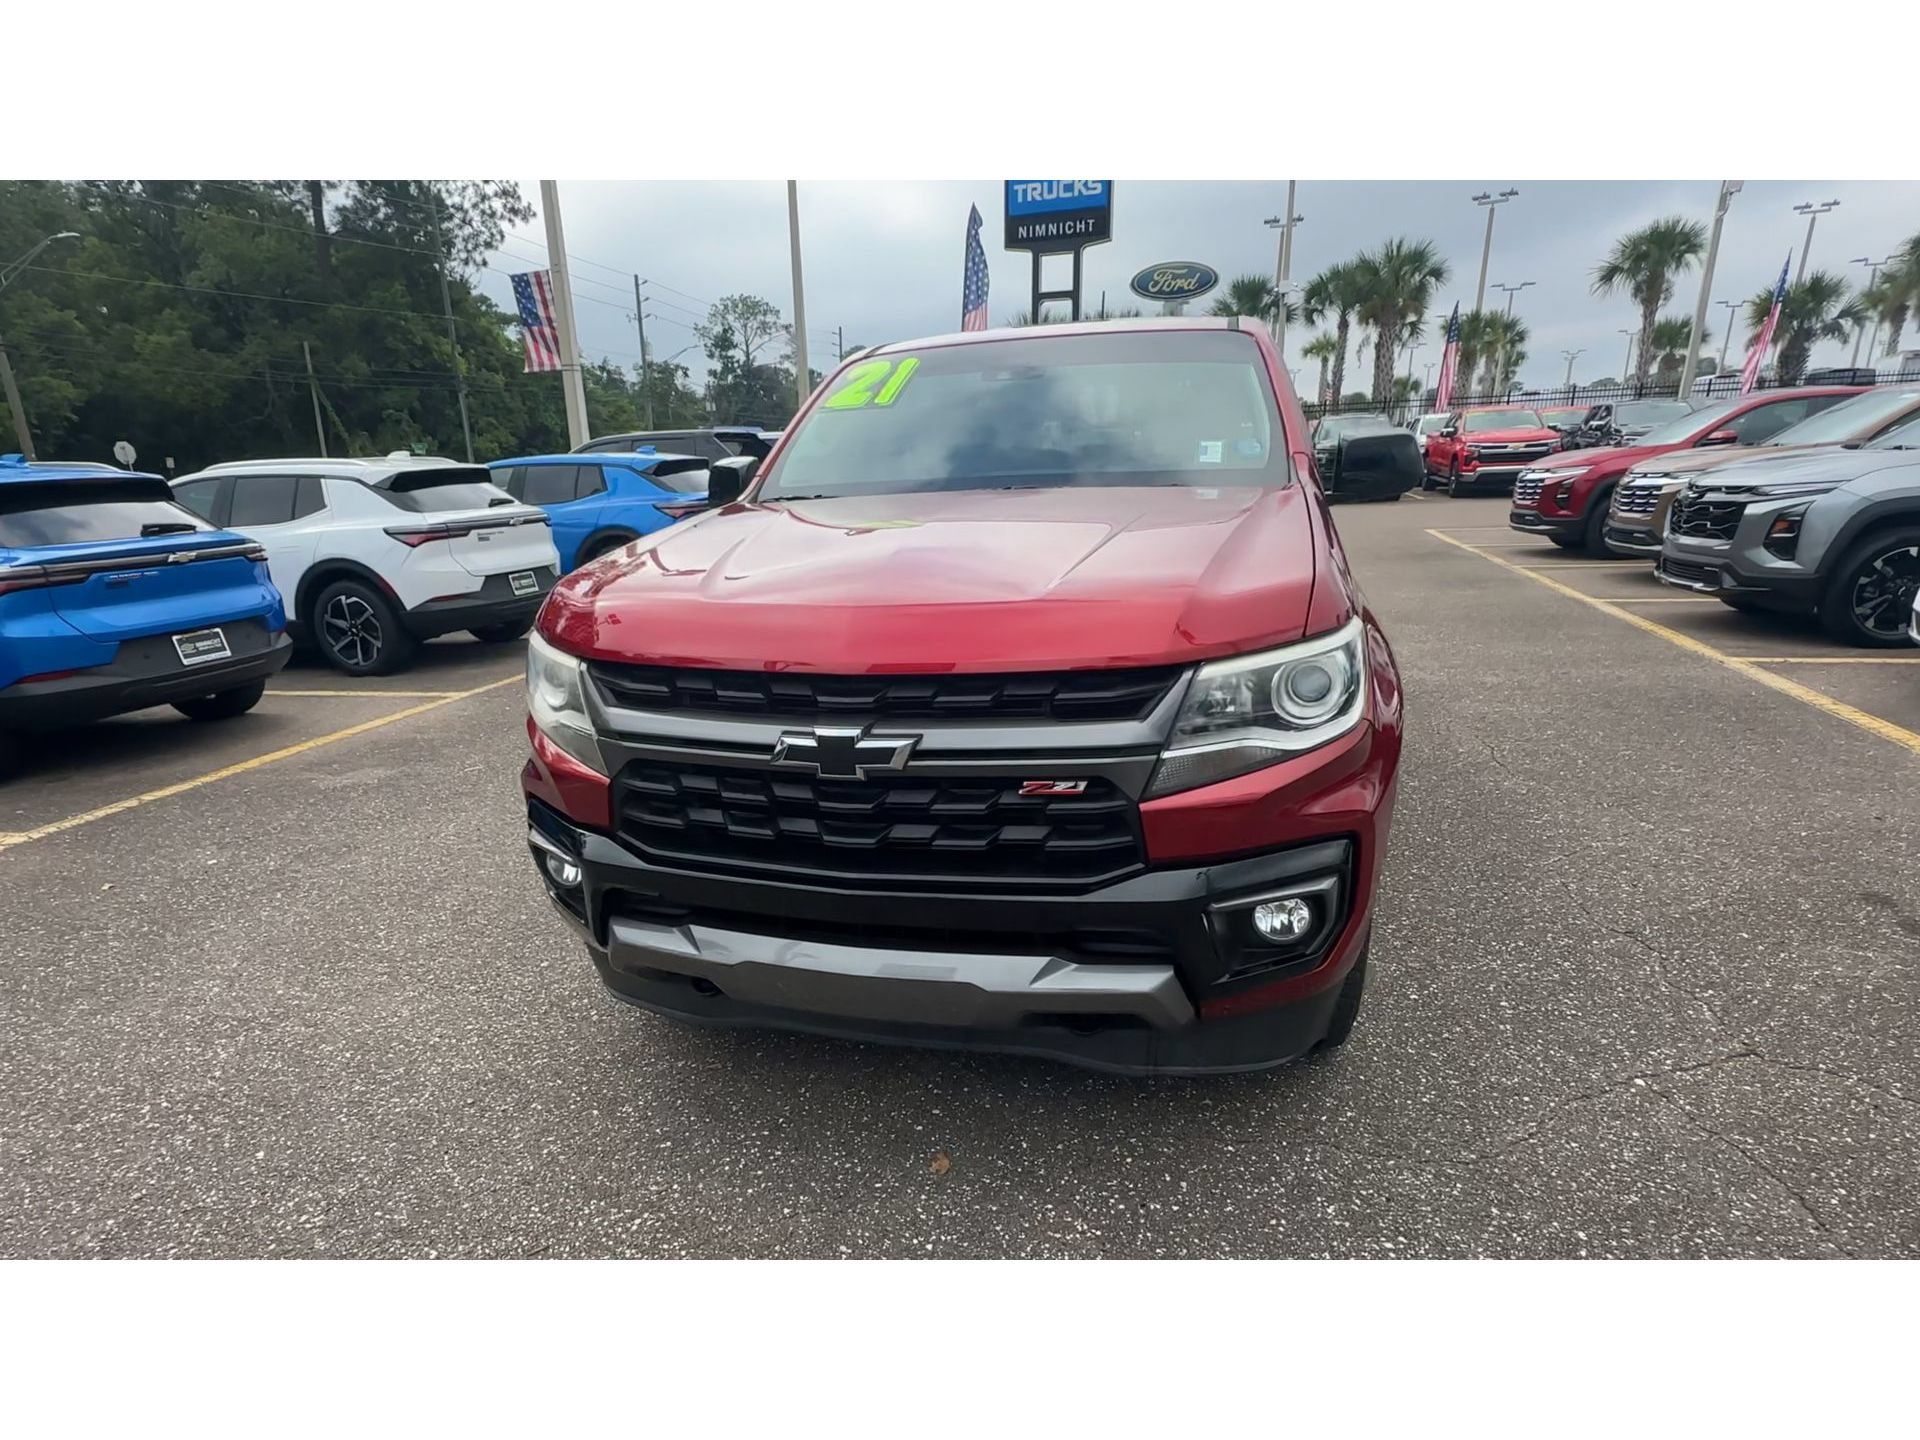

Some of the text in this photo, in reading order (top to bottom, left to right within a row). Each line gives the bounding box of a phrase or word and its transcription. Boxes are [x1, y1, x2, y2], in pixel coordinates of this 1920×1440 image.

[1013, 180, 1102, 203] TRUCKS
[1018, 219, 1096, 239] NIMNICHT
[1149, 268, 1200, 293] Ford
[825, 358, 920, 409] 21
[1019, 781, 1088, 795] Z71
